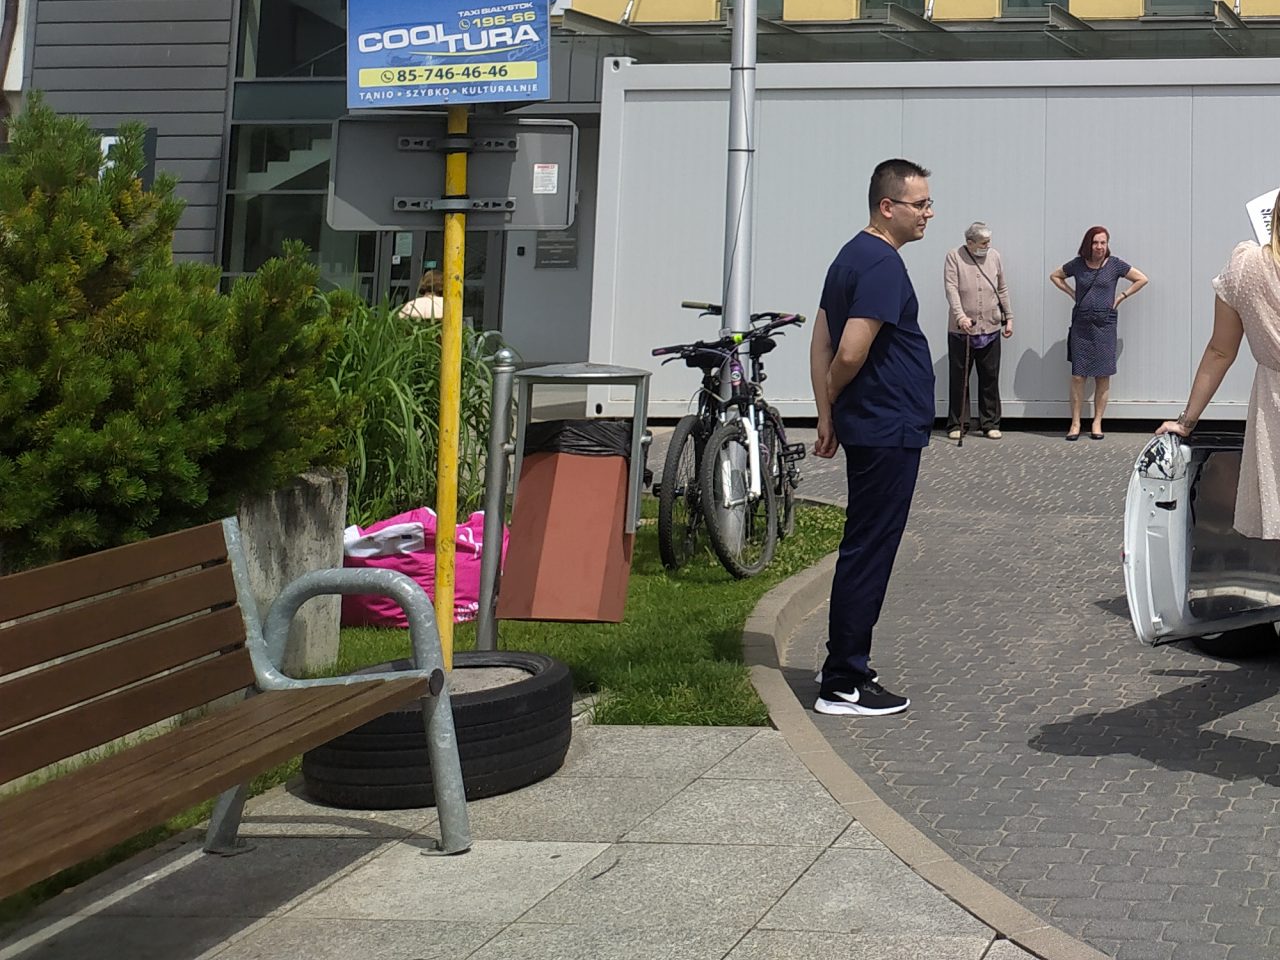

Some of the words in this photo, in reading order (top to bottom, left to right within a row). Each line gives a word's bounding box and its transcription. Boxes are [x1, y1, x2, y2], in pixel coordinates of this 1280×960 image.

[457, 8, 480, 18] TAXI
[472, 11, 536, 28] 196-66
[396, 64, 509, 83] 85-746-46-46
[359, 90, 394, 100] TANIO
[406, 87, 450, 98] SZYBKO
[461, 83, 538, 95] KULTURALNIE
